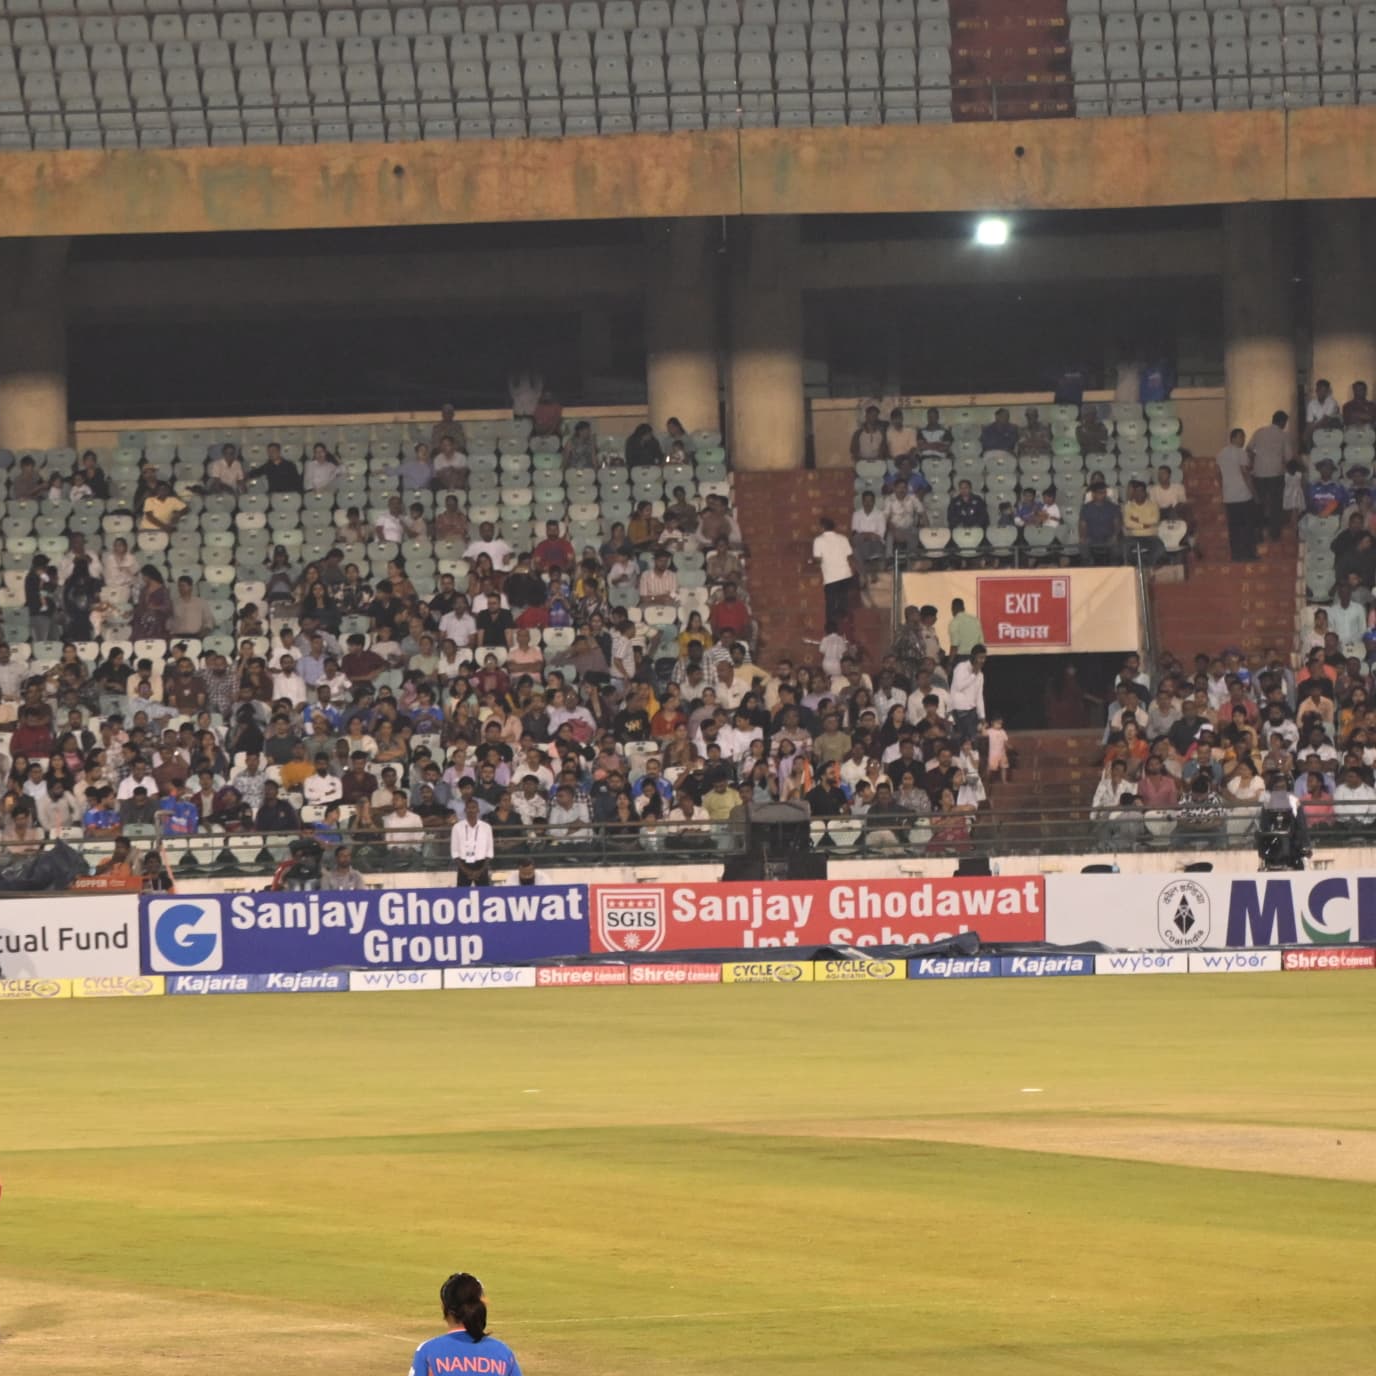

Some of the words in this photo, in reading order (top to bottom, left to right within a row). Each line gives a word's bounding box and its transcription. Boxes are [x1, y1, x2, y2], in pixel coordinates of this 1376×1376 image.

[1005, 593, 1041, 614] EXIT
[998, 621, 1049, 640] निकास
[231, 896, 369, 935] Sanjay
[378, 887, 583, 927] Ghodawat
[672, 888, 813, 928] Sanjay
[829, 880, 1039, 919] Ghodawat
[607, 911, 657, 928] SGIS
[59, 923, 129, 953] Fund
[363, 929, 485, 965] Group
[733, 965, 773, 976] CYCLE
[825, 961, 866, 973] CYCLE
[919, 957, 991, 978] Kajaria
[1011, 955, 1084, 976] Kajaria
[1287, 953, 1338, 969] Shree
[83, 976, 124, 989] CYCLE
[266, 972, 338, 991] Kajaria
[539, 969, 592, 984] Shree
[632, 967, 685, 982] Shree
[176, 975, 248, 994] Kajaria
[435, 1356, 507, 1376] NANDNI
